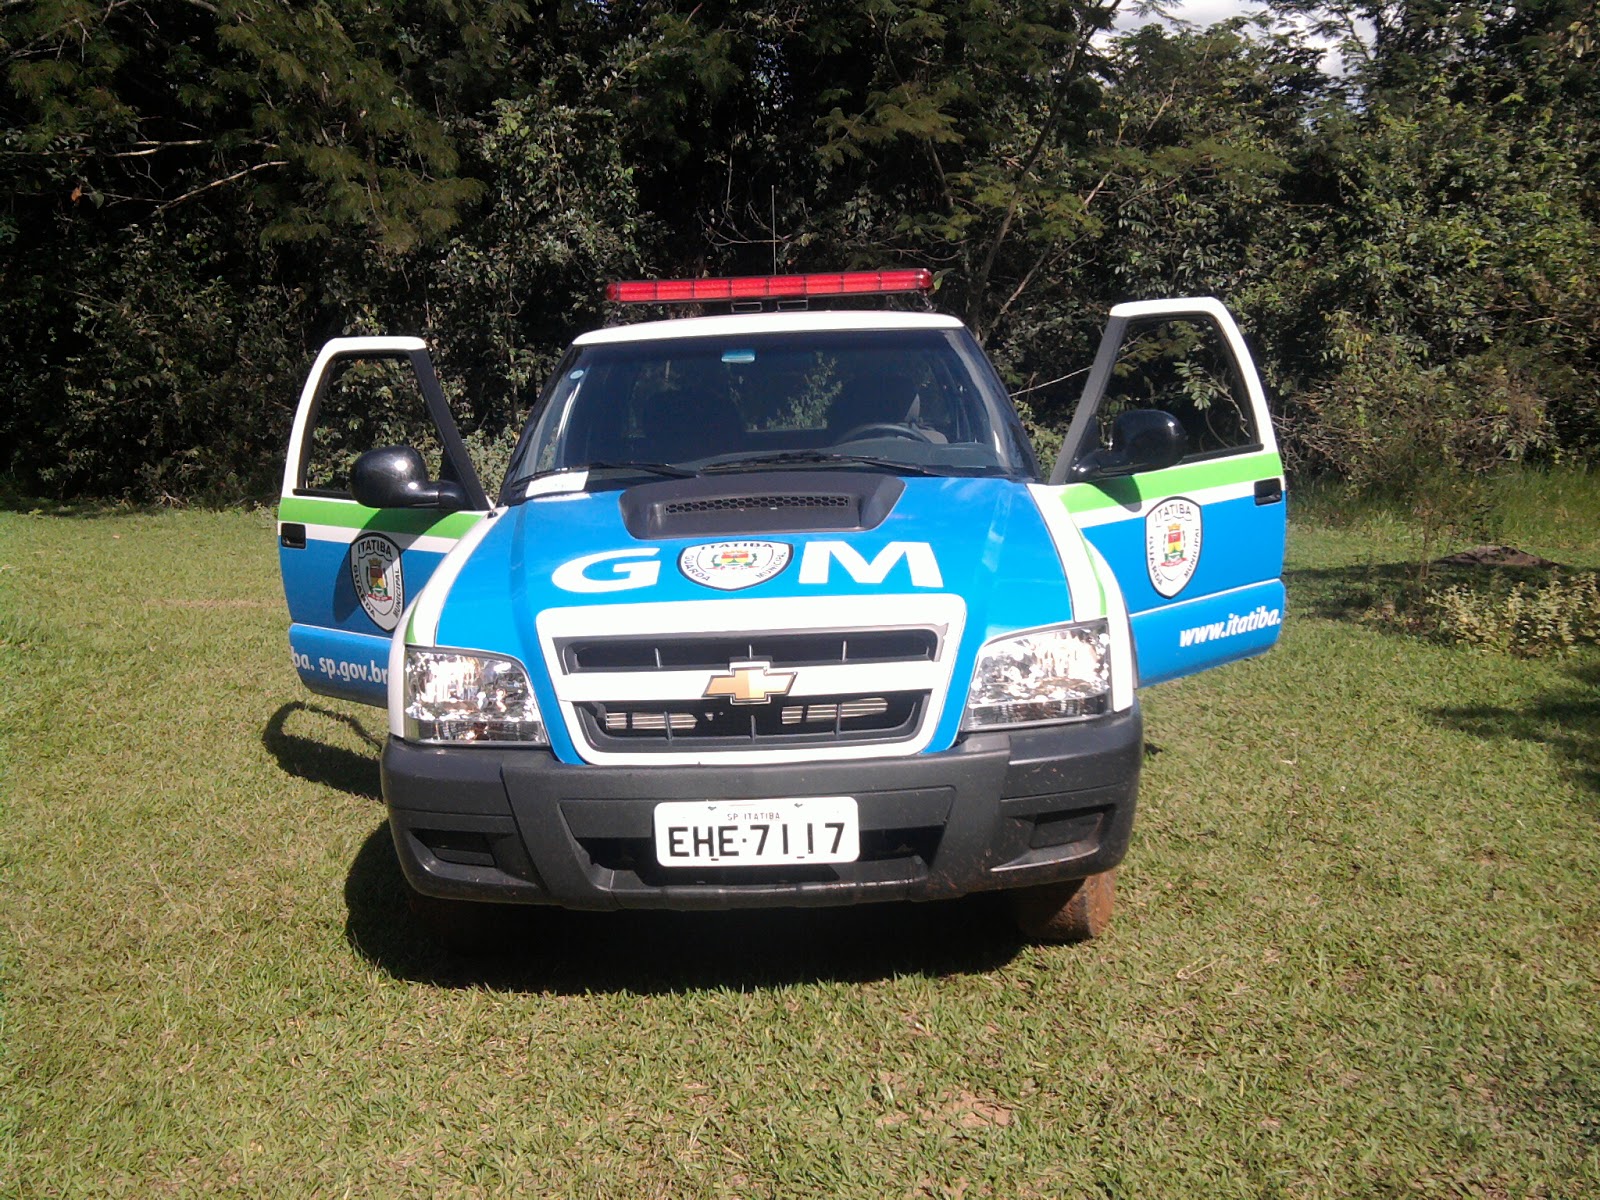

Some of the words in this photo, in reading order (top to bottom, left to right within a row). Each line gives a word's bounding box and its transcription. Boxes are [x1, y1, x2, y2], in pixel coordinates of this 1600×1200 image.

[1154, 503, 1192, 522] ITATIBA
[357, 539, 392, 557] ITATIBA
[684, 554, 711, 581] GUARDA
[353, 564, 376, 618] GUARDA
[393, 568, 402, 619] MUNICIPAL
[727, 812, 739, 821] SP
[744, 812, 781, 821] ITATIBA
